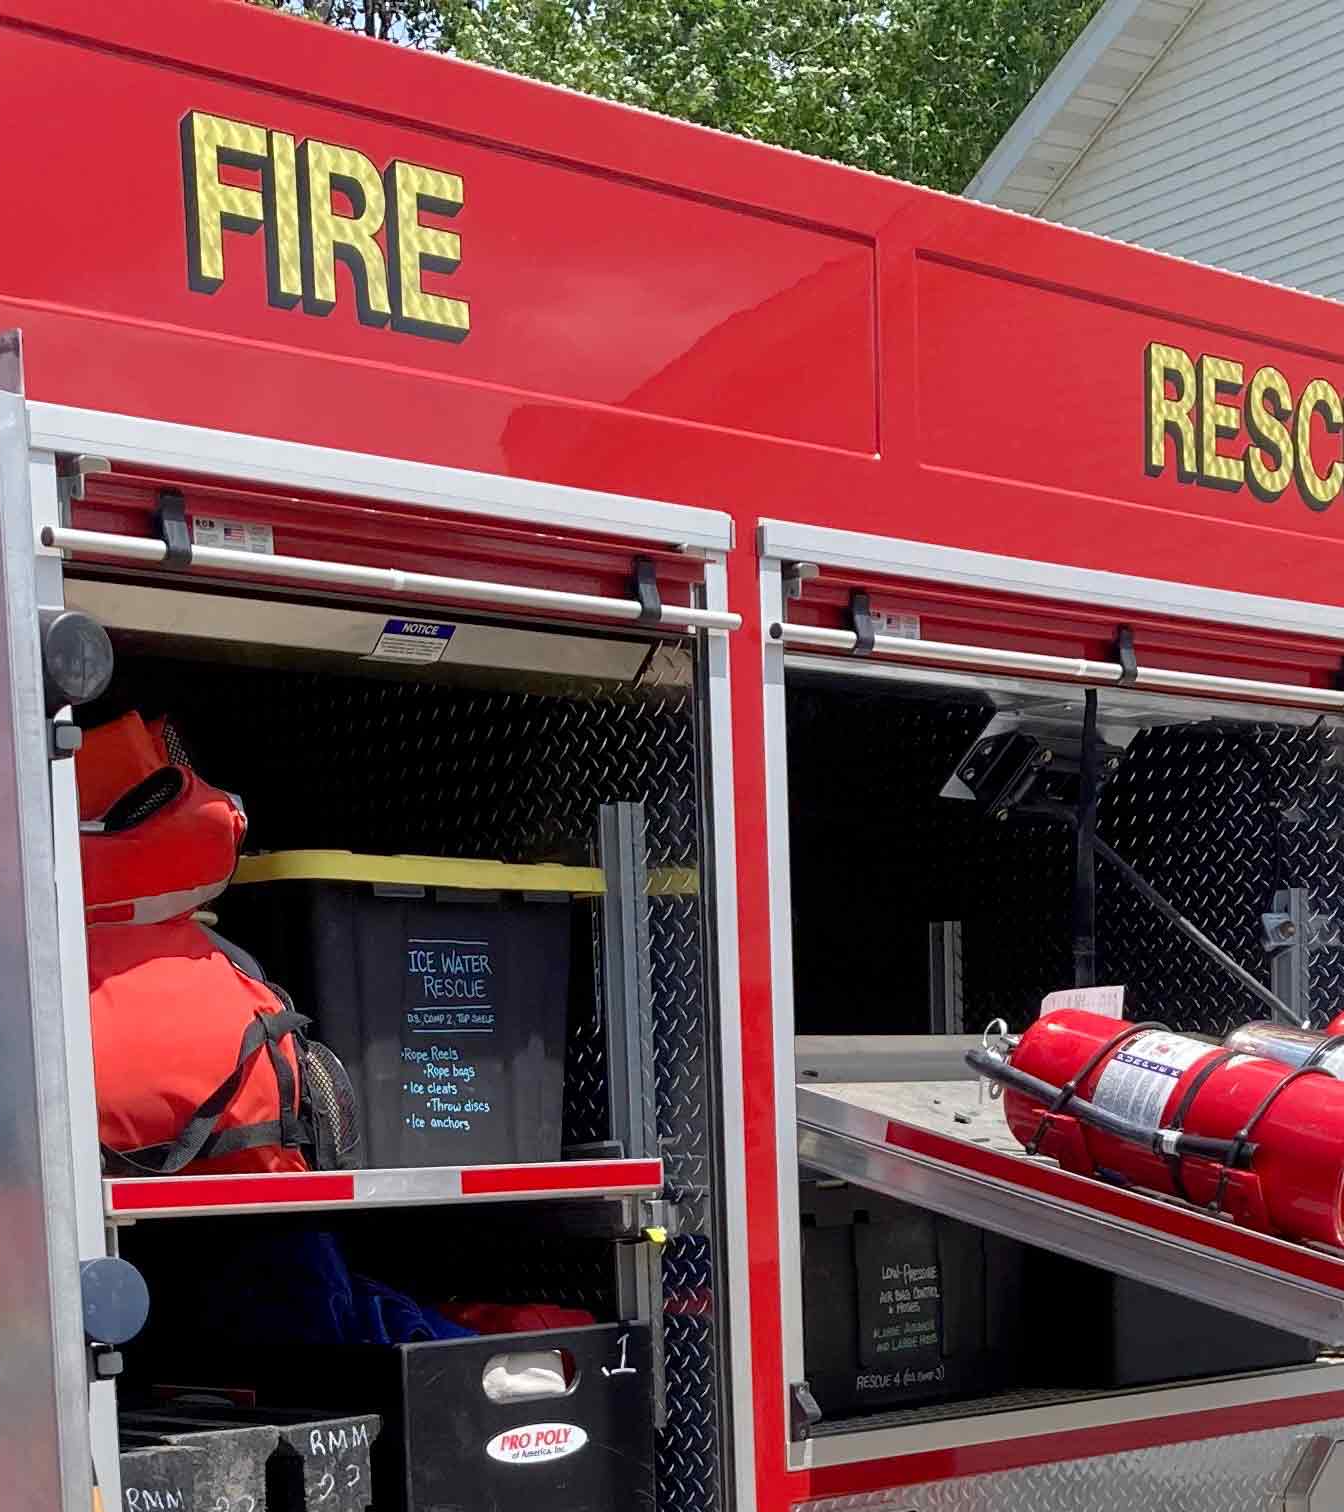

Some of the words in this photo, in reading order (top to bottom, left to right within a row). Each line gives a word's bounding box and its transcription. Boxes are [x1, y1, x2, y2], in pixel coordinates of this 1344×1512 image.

[179, 109, 470, 343] FIRE
[401, 622, 440, 635] NOTICE
[408, 951, 436, 973] ICE
[441, 948, 493, 975] WATER
[423, 975, 487, 999] RESCUE
[404, 1047, 429, 1063] Rope
[431, 1045, 459, 1061] Reels
[426, 1063, 450, 1080] Rope
[452, 1063, 476, 1082] bags
[410, 1081, 425, 1095] Ice
[427, 1082, 458, 1095] cleats
[430, 1097, 462, 1113] Throw
[464, 1099, 490, 1113] discs
[412, 1112, 426, 1129] Ice
[430, 1116, 471, 1131] anchors
[856, 1373, 892, 1392] RESCUE
[310, 1423, 369, 1456] RMM
[500, 1432, 532, 1451] PRO
[534, 1426, 572, 1447] POLY
